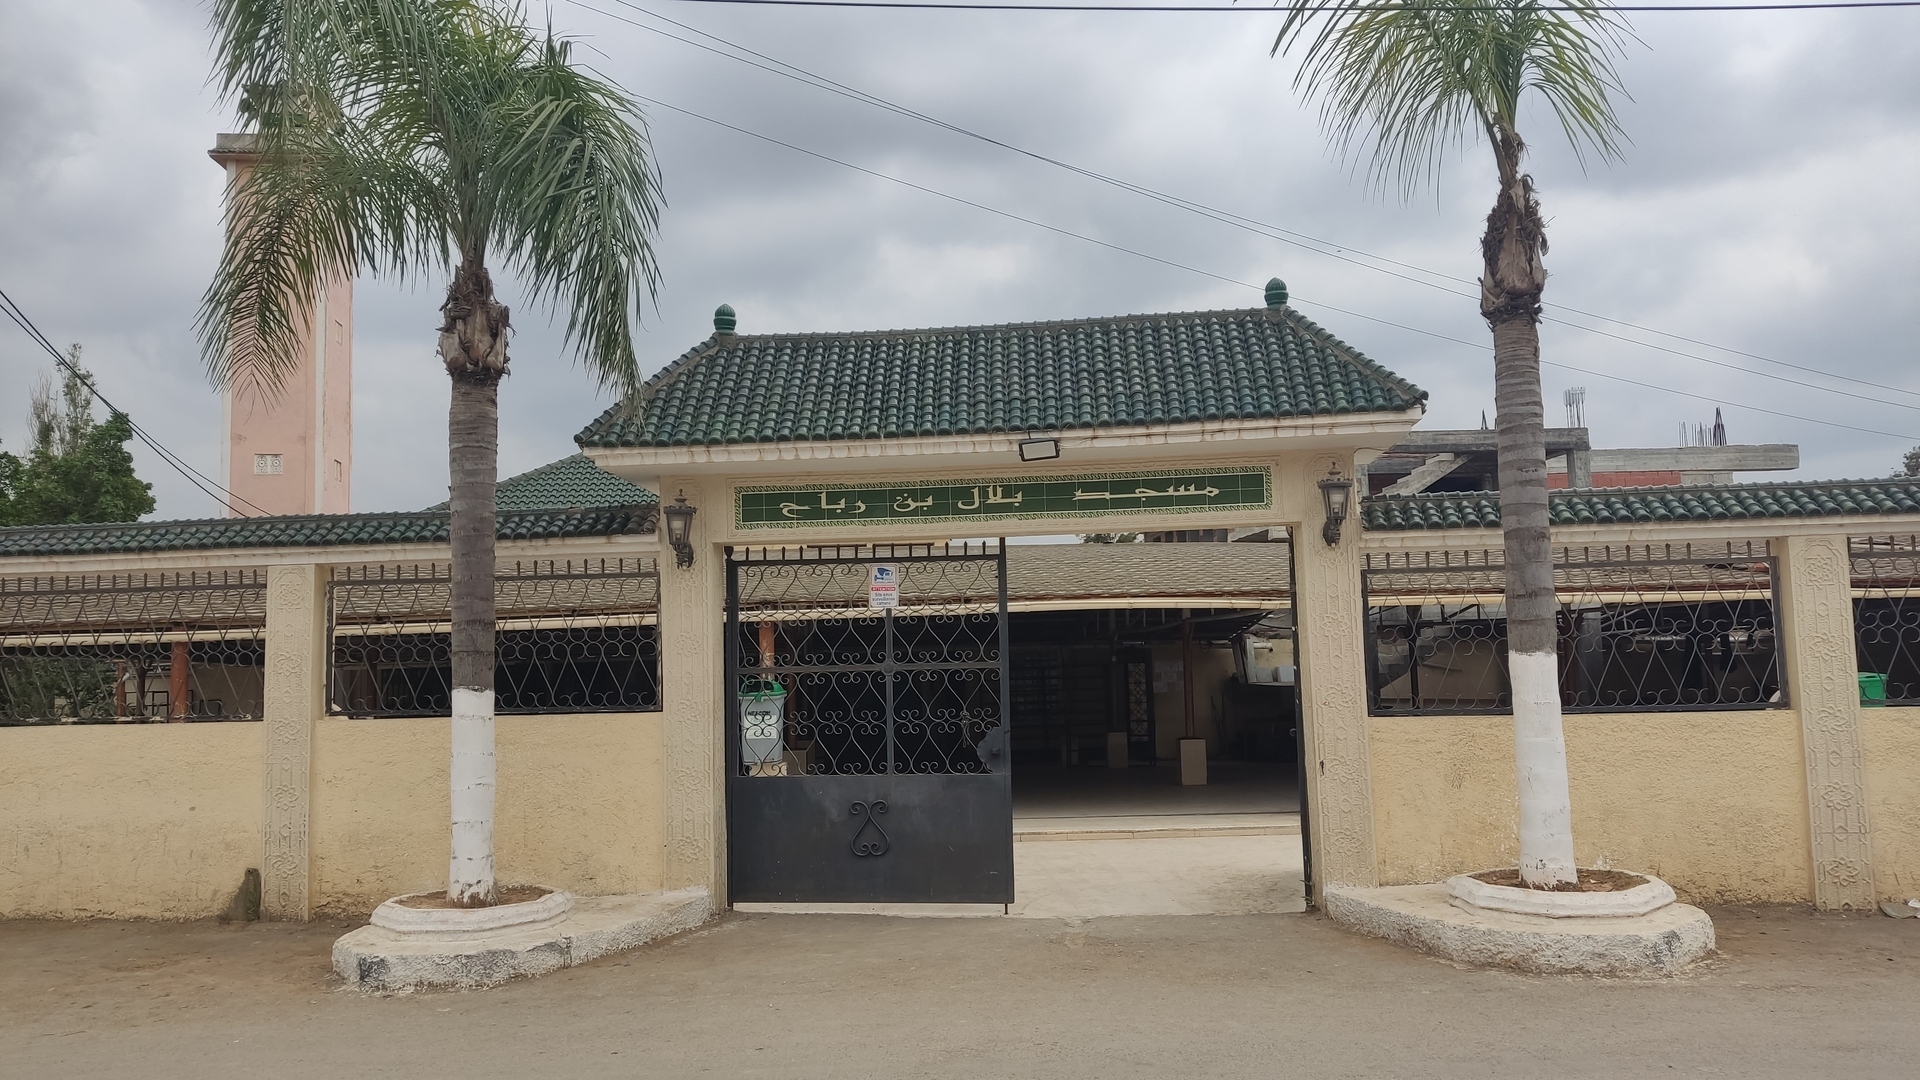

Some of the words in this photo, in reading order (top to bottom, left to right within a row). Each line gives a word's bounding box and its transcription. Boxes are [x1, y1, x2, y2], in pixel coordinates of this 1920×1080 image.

[779, 490, 867, 518] رباح
[892, 492, 933, 513] بن
[956, 484, 1023, 509] بلال
[1072, 483, 1220, 502] مسجد
